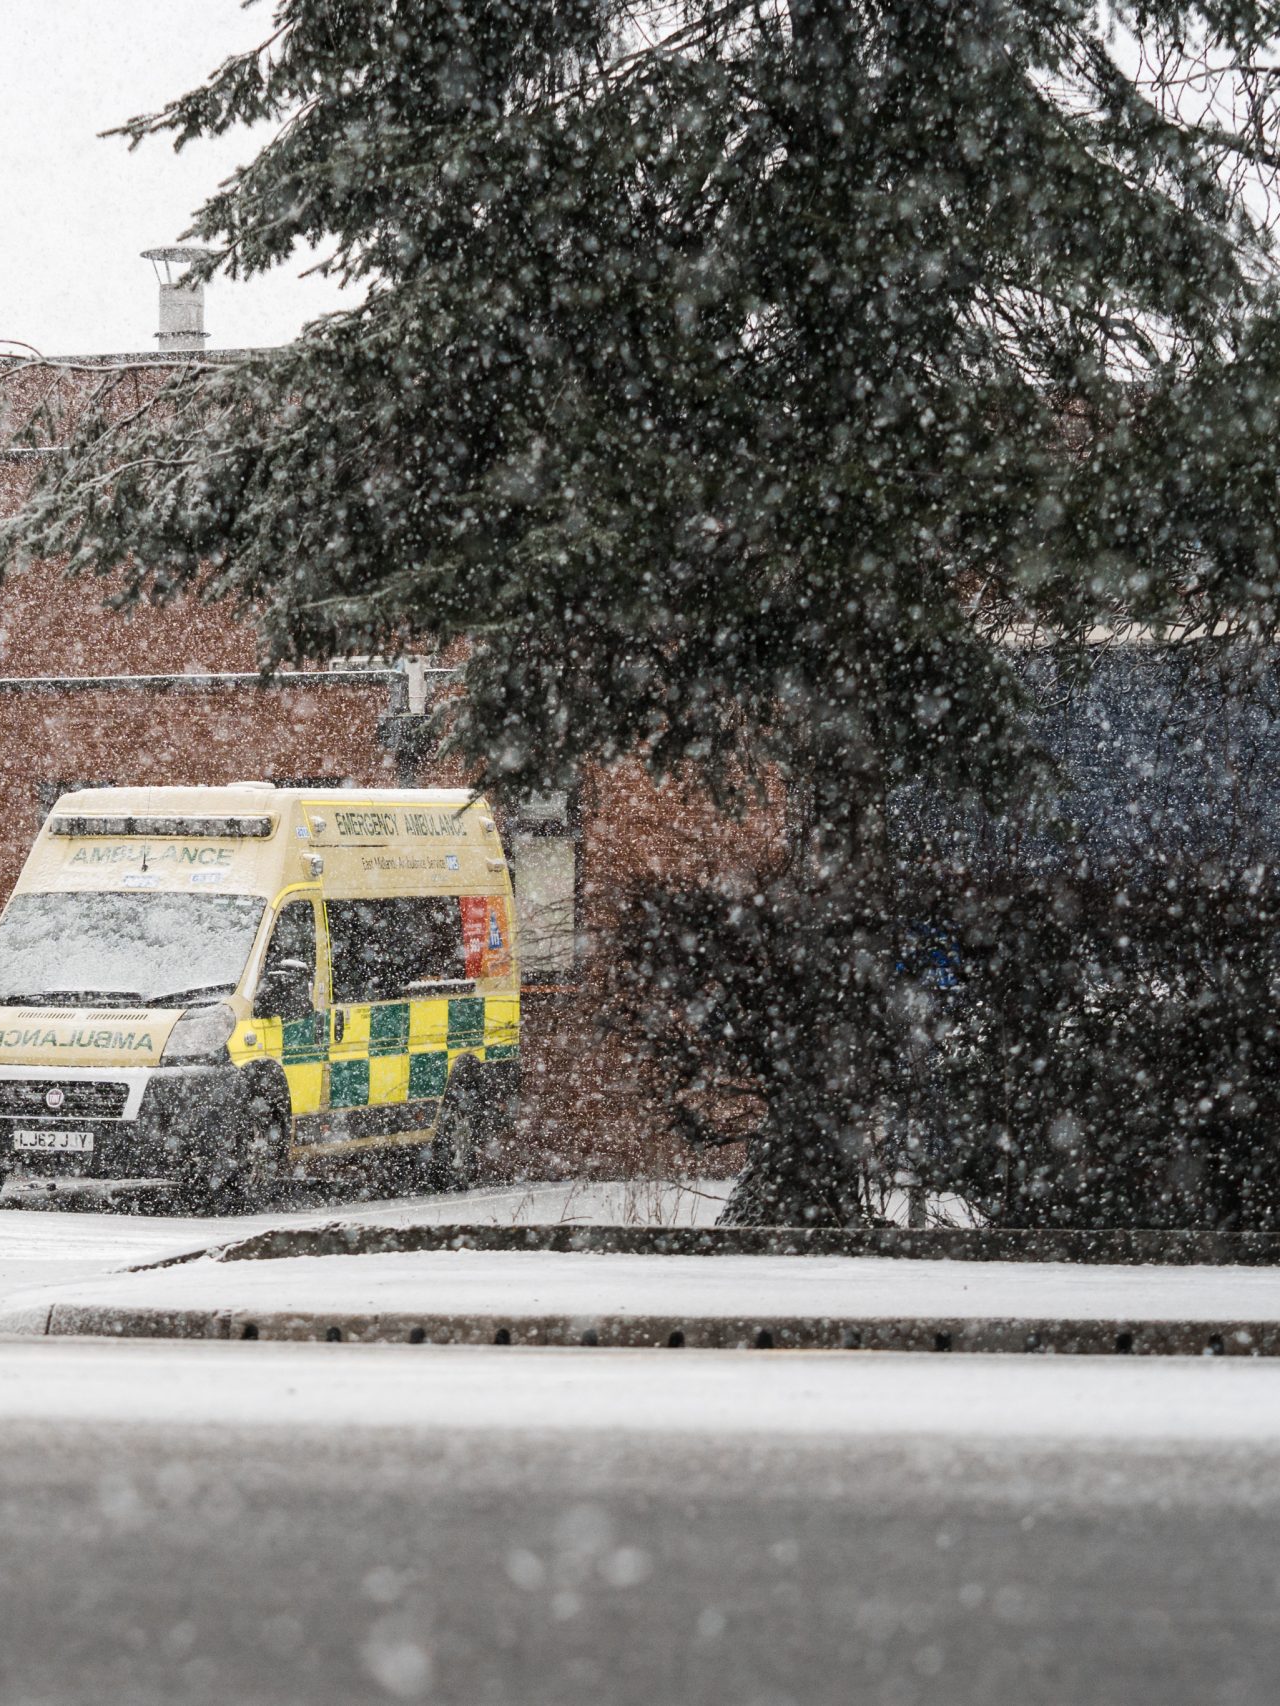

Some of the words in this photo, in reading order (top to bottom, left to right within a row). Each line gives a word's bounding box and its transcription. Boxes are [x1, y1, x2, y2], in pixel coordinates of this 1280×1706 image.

[334, 812, 399, 836] EMERGENCY
[403, 814, 468, 836] AMBULANCE
[70, 845, 235, 866] AMBULANCE
[20, 1132, 56, 1147] LJ62
